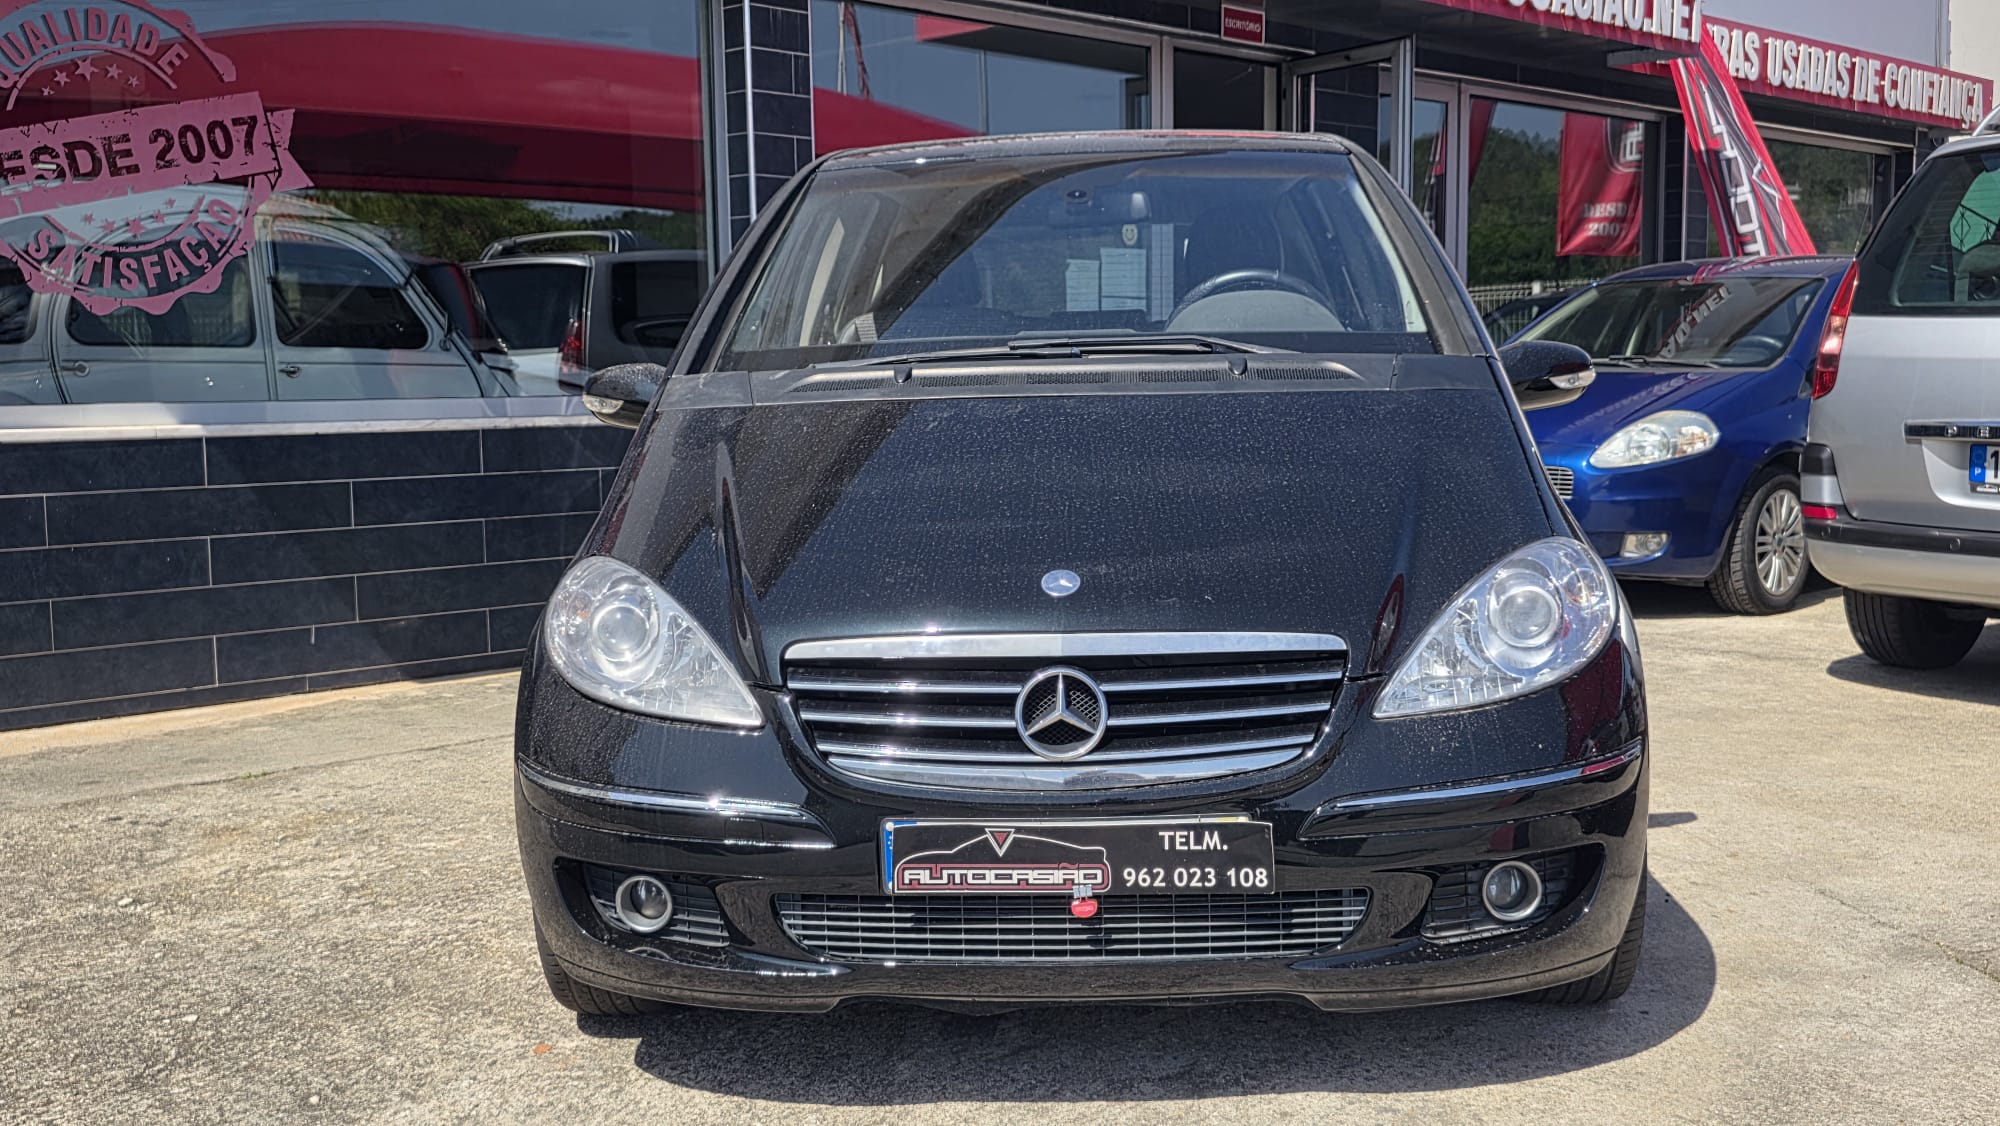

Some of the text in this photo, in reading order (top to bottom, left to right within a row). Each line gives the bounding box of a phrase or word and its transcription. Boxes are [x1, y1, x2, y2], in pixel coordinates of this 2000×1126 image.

[1764, 37, 1850, 99] USADAS
[1852, 55, 1880, 104] DE
[1884, 62, 1984, 129] CONFIANÇA
[149, 115, 258, 172] 2007
[1158, 831, 1229, 850] TELM.
[903, 862, 1103, 885] AUTOCASIÃO
[1122, 867, 1269, 888] 962 023 108
